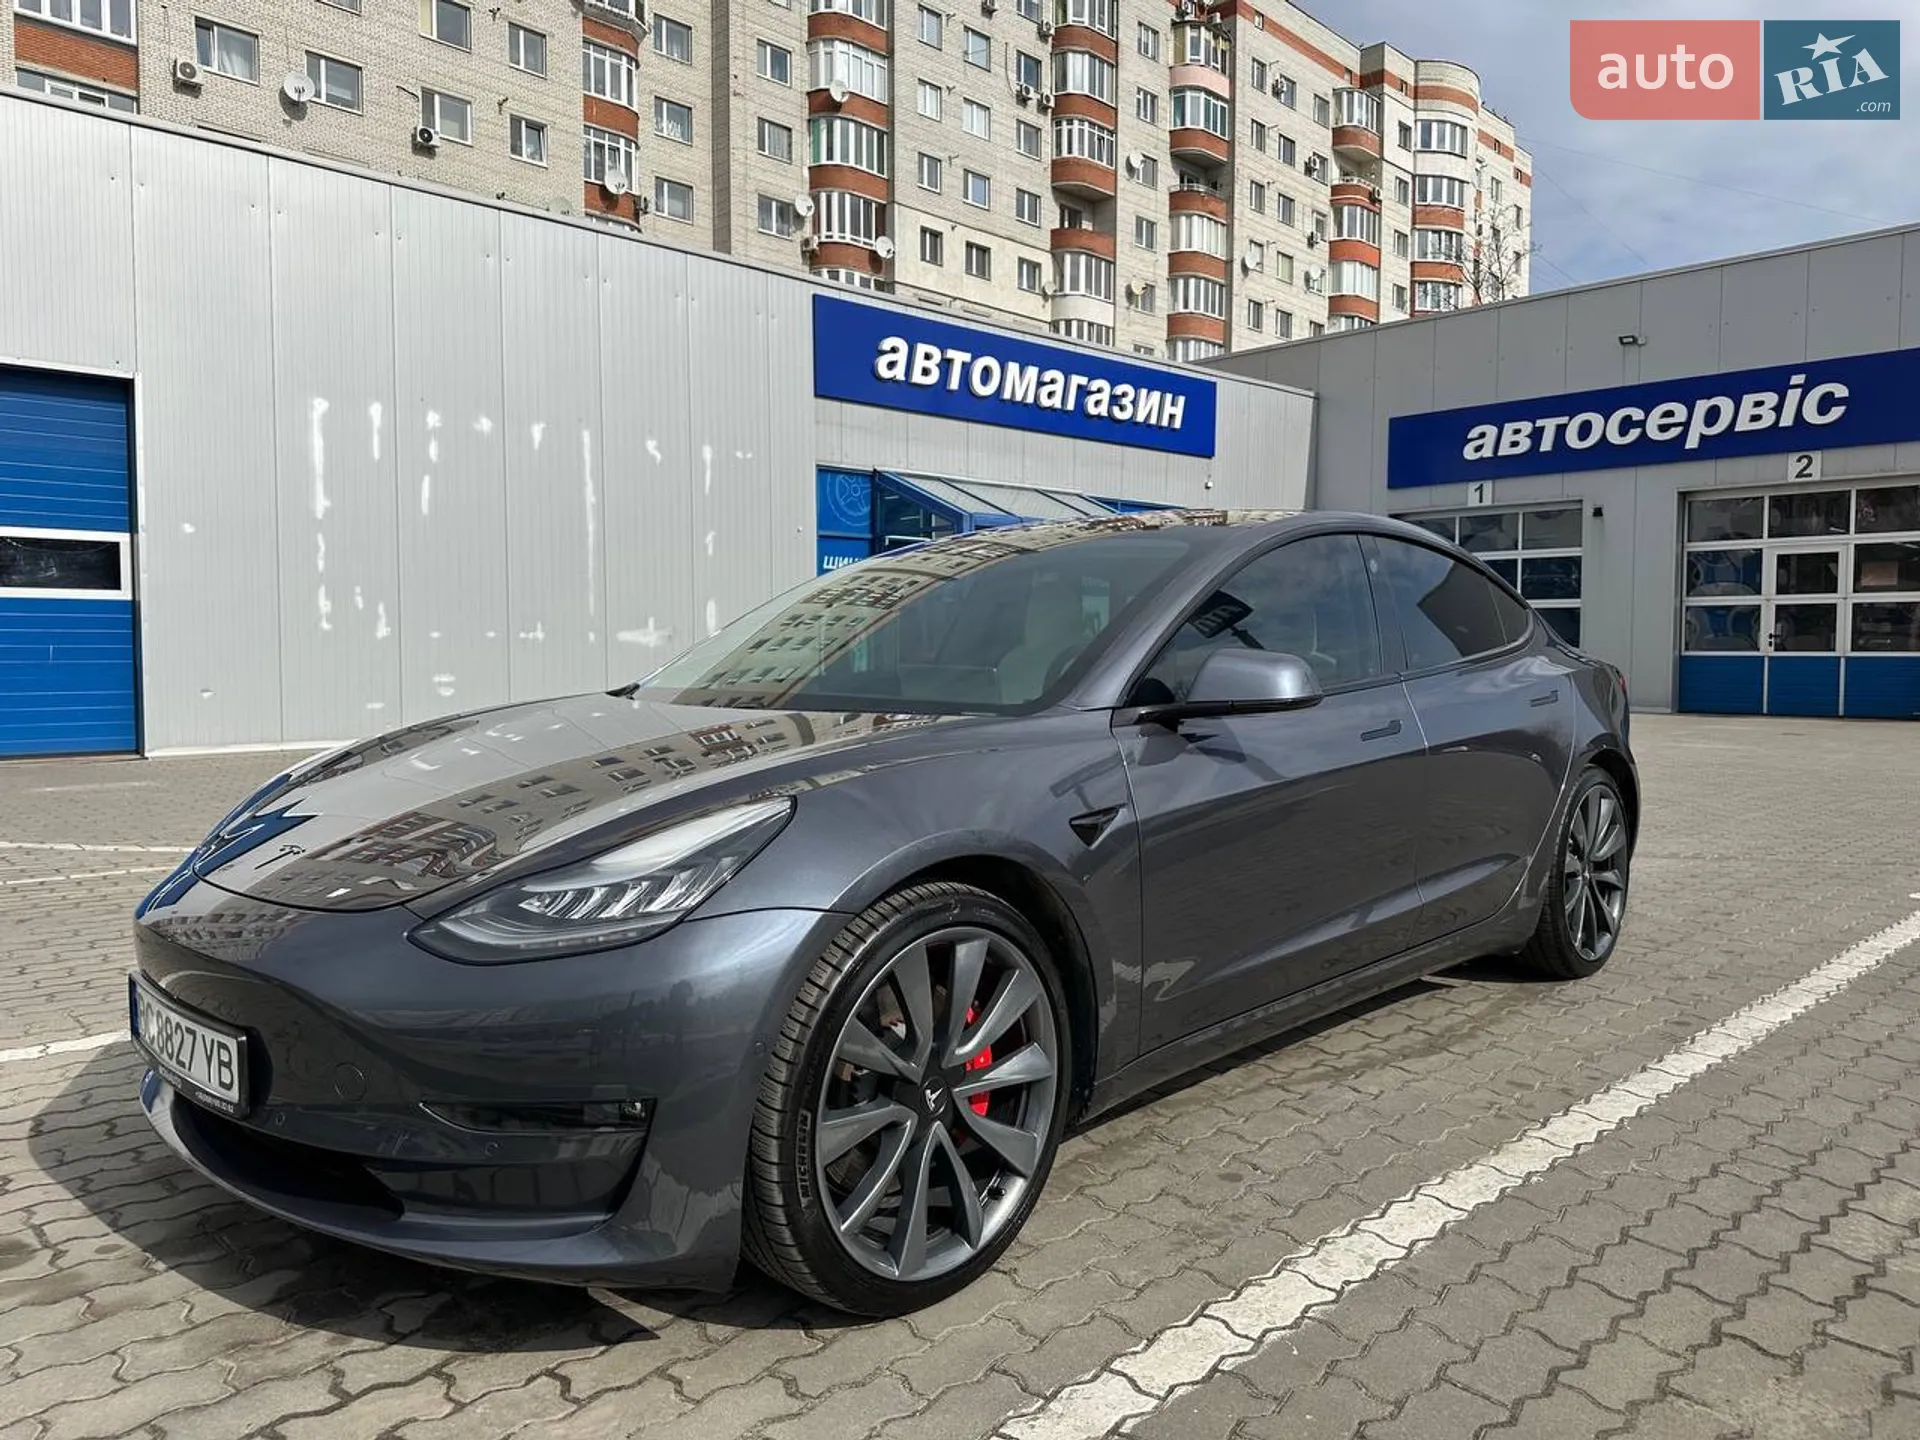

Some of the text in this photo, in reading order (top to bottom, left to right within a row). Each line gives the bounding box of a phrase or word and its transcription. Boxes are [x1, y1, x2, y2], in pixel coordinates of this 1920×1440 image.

[874, 336, 1187, 430] автомагазин
[1462, 374, 1850, 461] автосервіс
[1473, 483, 1485, 504] 1
[1793, 454, 1814, 479] 2
